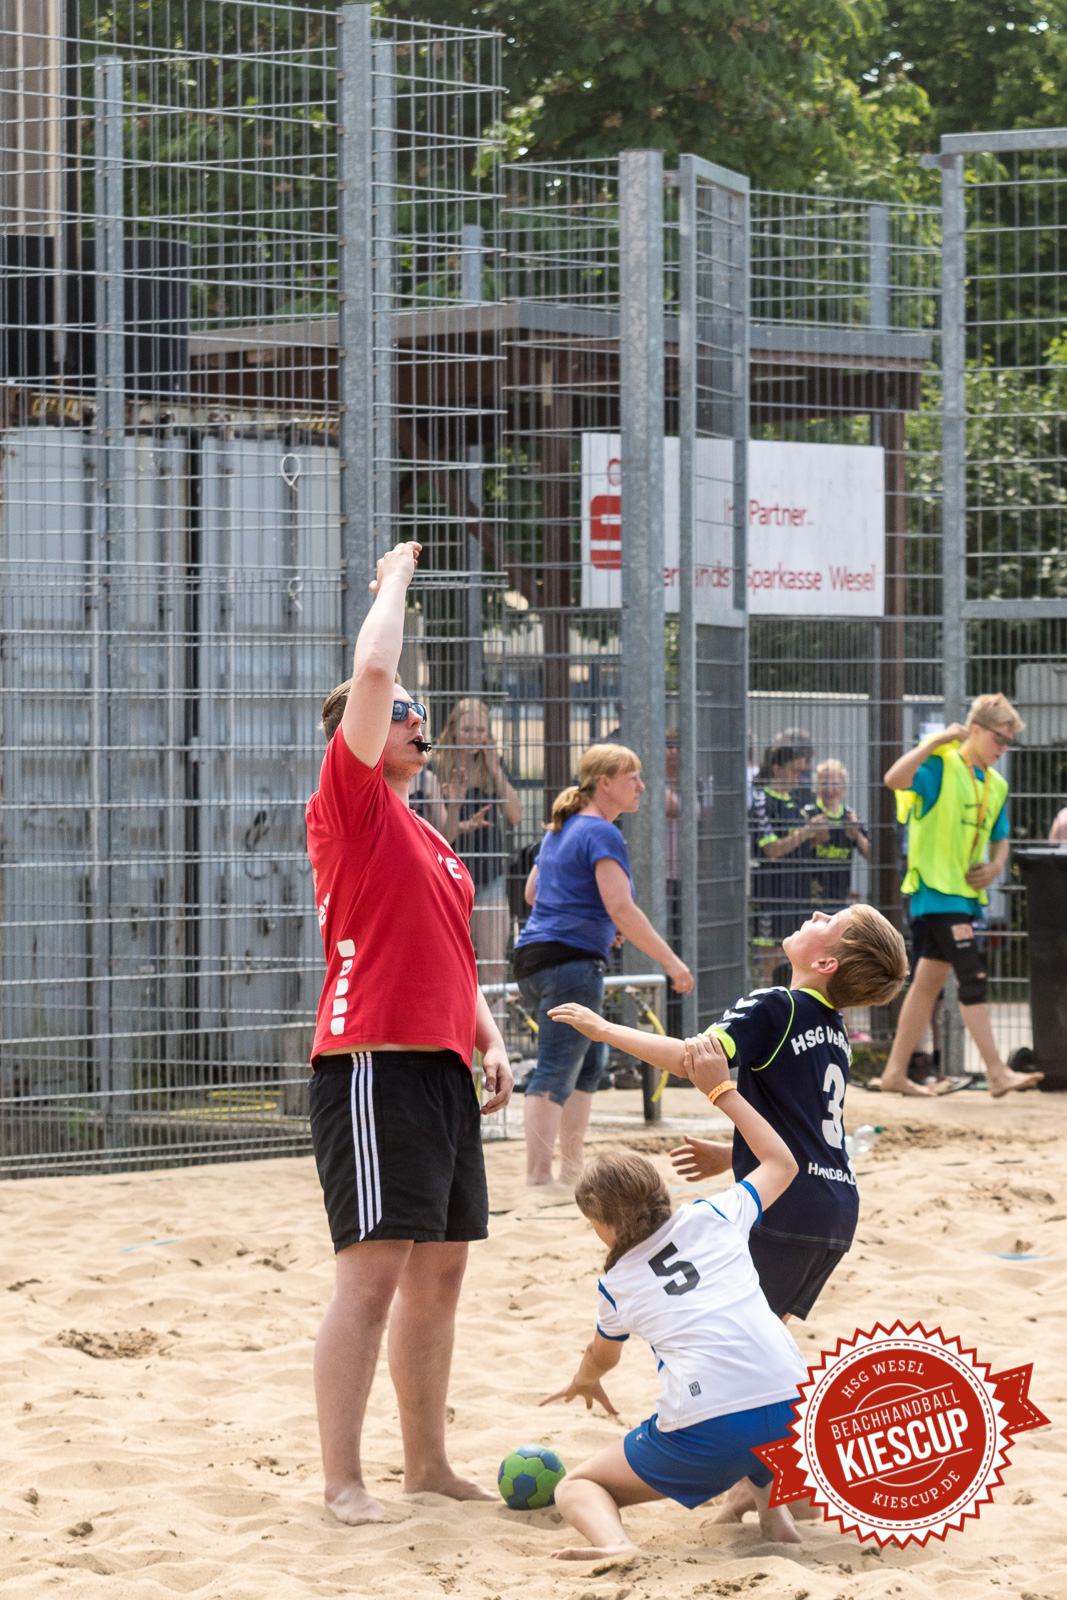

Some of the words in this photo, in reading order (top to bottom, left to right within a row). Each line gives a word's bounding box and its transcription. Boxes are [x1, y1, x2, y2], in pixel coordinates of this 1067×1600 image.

[829, 564, 876, 591] Wesel
[791, 1025, 825, 1056] HSG
[821, 1063, 846, 1149] 3
[808, 1161, 857, 1186] HANDBAL
[648, 1241, 701, 1296] 5
